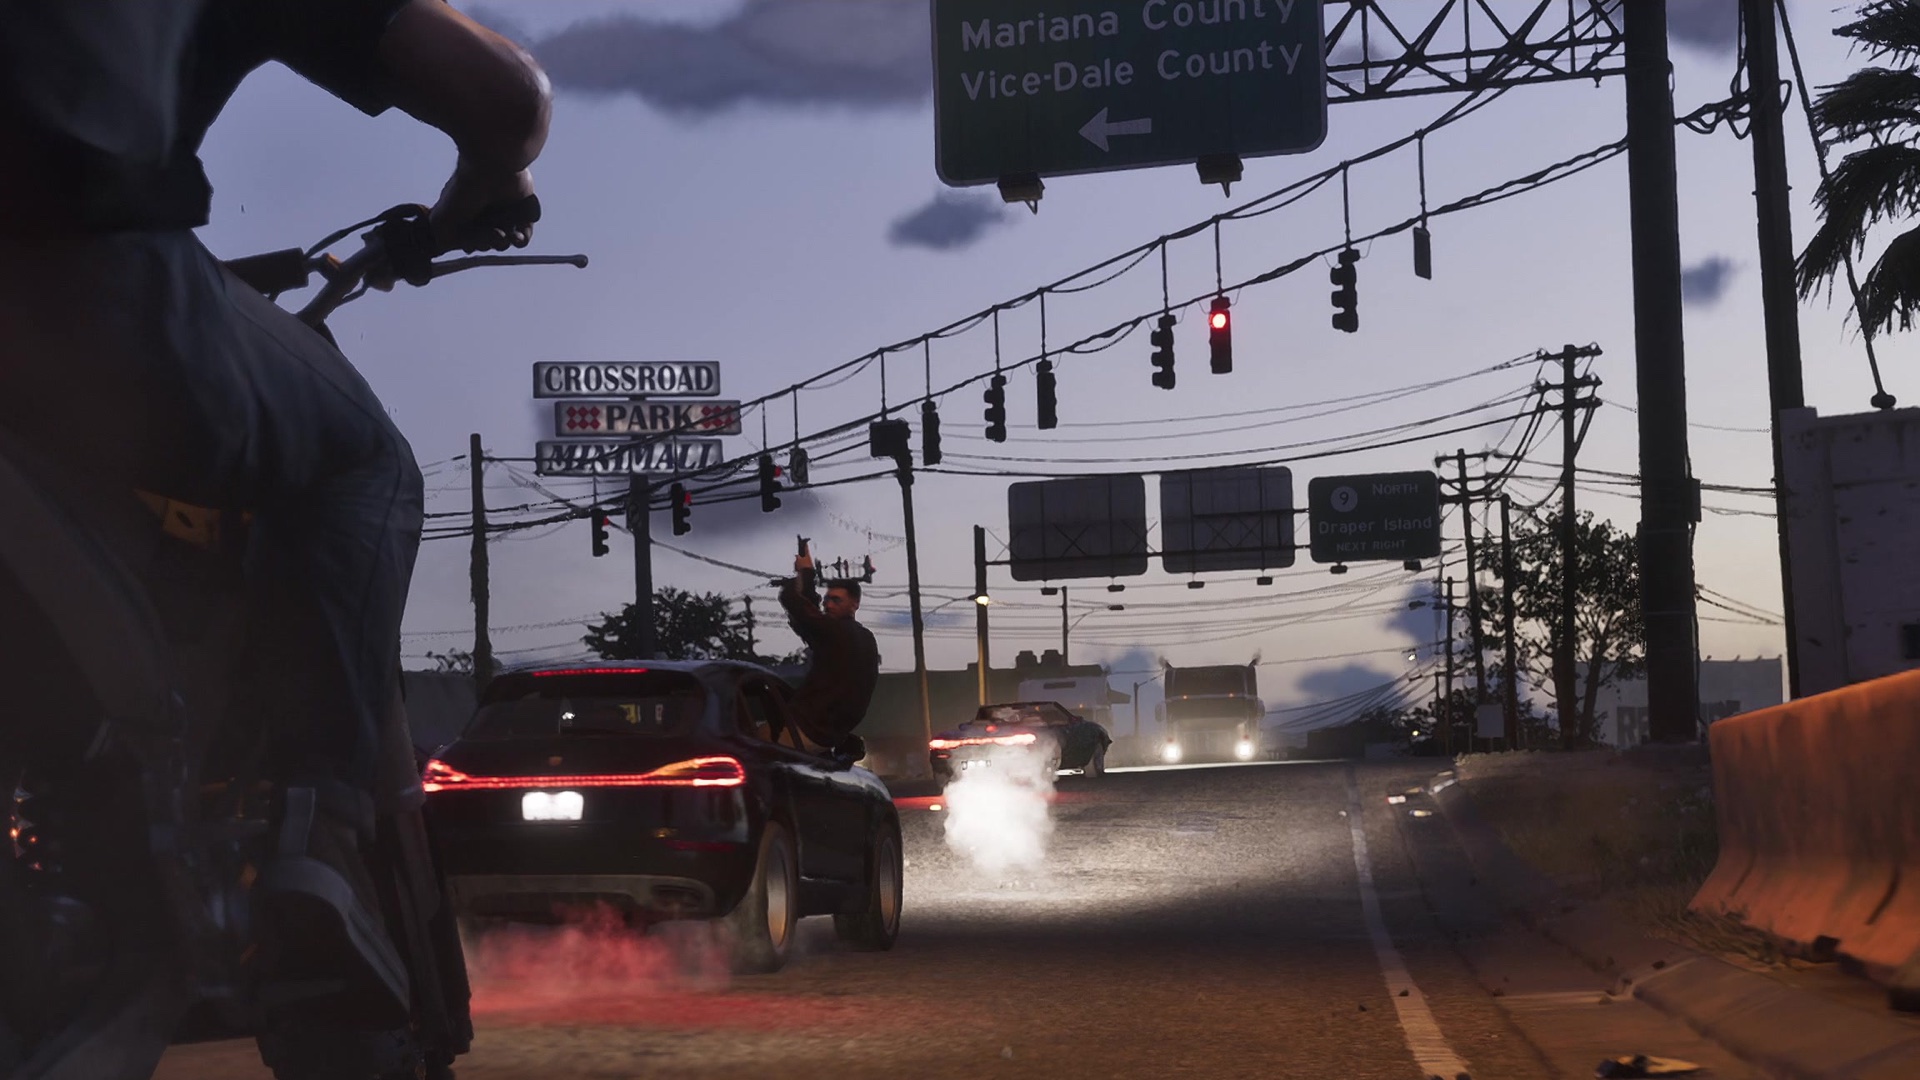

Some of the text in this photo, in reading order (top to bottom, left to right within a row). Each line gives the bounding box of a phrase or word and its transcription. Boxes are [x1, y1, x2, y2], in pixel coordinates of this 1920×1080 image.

[961, 0, 1294, 52] Mariana County
[961, 40, 1303, 101] Vice-Dale County
[544, 365, 714, 392] CROSSROAD
[605, 404, 698, 431] PARK
[1339, 491, 1350, 506] 9
[1372, 483, 1419, 495] NORTH
[1318, 516, 1432, 535] Draper Island
[1336, 539, 1407, 553] NEXT RIGHT
